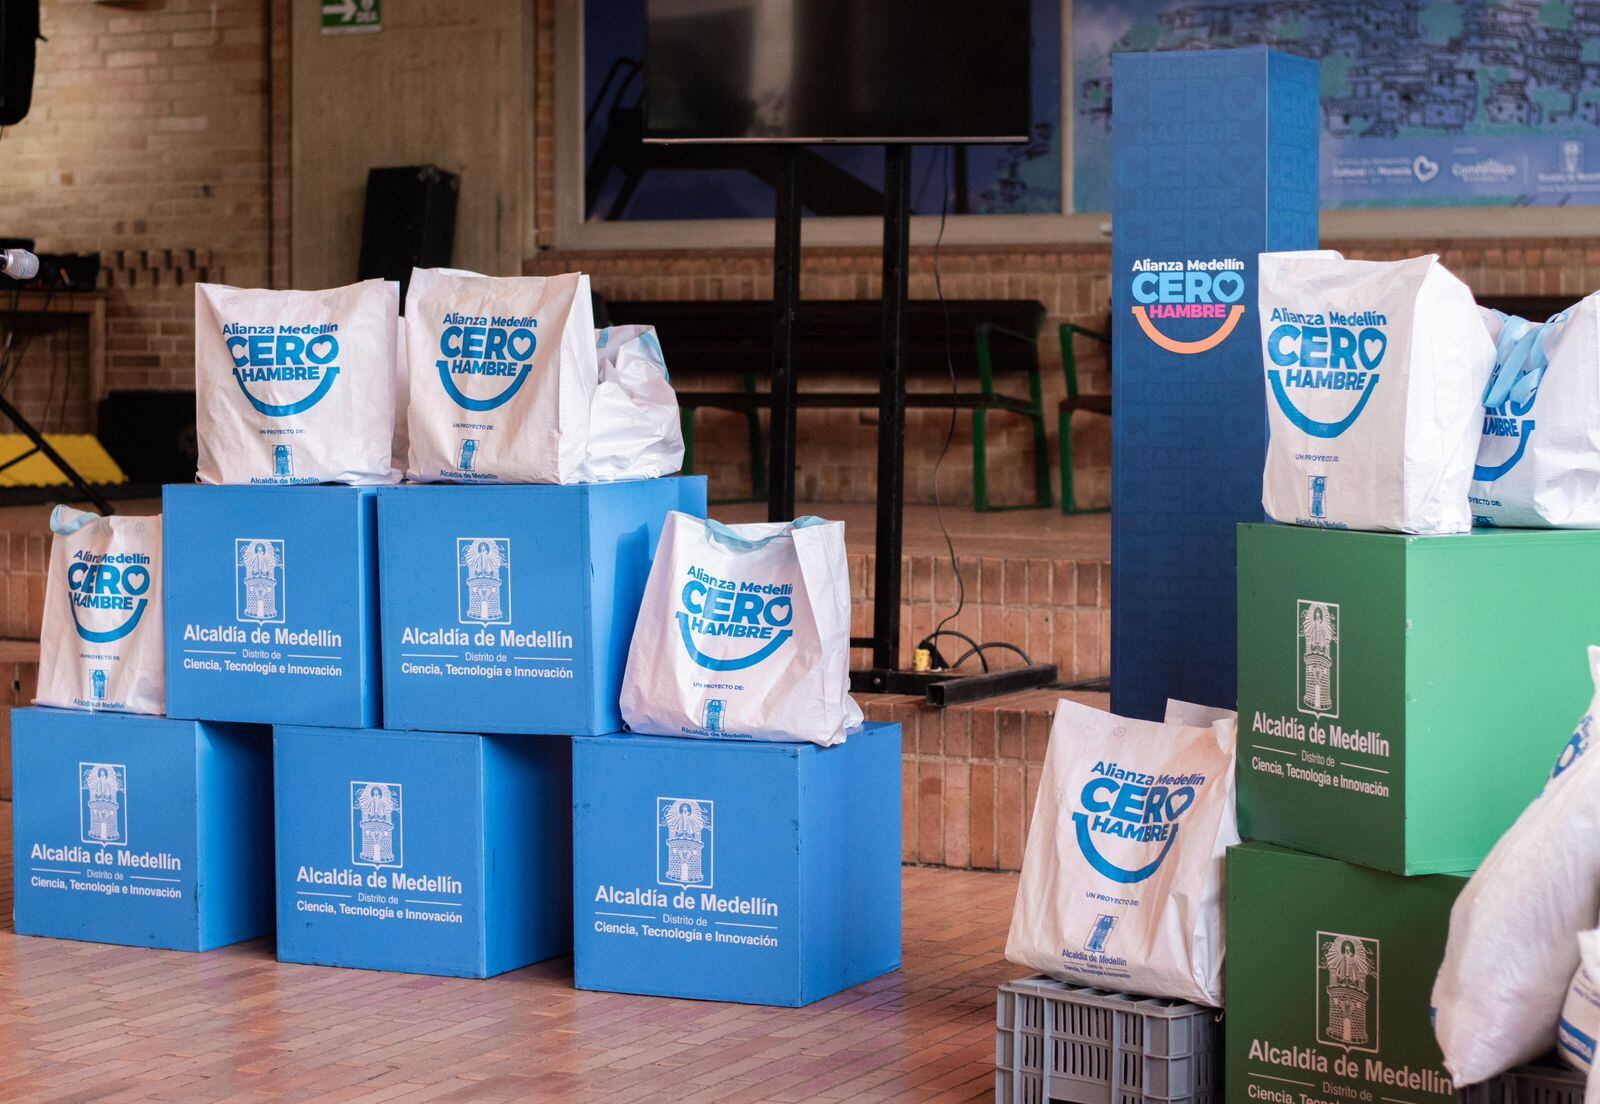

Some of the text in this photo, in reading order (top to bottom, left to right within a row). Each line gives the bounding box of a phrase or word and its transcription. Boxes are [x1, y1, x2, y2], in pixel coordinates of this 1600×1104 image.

[1132, 258, 1244, 271] Alianza Medellín
[1132, 271, 1244, 303] CERO
[443, 313, 538, 327] Alianza Medellín
[1150, 304, 1226, 318] HAMBRE
[1271, 307, 1387, 326] Alianza Medellín
[223, 322, 338, 335] Alianza Medellín
[226, 335, 339, 367] CERO
[440, 326, 536, 361] CERO
[1268, 324, 1387, 370] CERO
[242, 367, 320, 382] HAMBRE
[452, 360, 518, 376] HAMBRE
[1286, 369, 1367, 390] HAMBRE
[68, 562, 150, 596] CERO
[688, 566, 793, 595] Alianza Medellí
[74, 592, 133, 610] HAMBRE
[682, 580, 793, 626] CERO
[184, 624, 342, 647] Alcaldía de Medellín
[401, 628, 572, 648] Alcaldía de Medellín
[691, 617, 773, 639] HAMBRE
[243, 649, 281, 660] Distrito de
[465, 652, 507, 662] Distrito de
[184, 658, 342, 676] Ciencia, Tecnología e Innovación
[402, 663, 573, 678] Ciencia, Tecnología e Innovación
[1252, 711, 1389, 757] Alcaldía de Medellín
[1302, 750, 1335, 767] Distrito de
[1091, 761, 1205, 785] Alianza Medellín
[1252, 756, 1389, 797] Ciencia, Tecnología e Innovación
[1081, 777, 1195, 824] CERO
[1091, 816, 1170, 842] HAMBRE
[31, 843, 180, 870] Alcaldía de Medellín
[87, 869, 124, 881] Distrito de
[297, 866, 462, 894] Alcaldía de Medellín
[31, 876, 181, 898] Ciencia, Tecnología e Innovación
[358, 893, 398, 904] Distrito de
[595, 885, 778, 916] Alcaldía de Medellín
[1096, 894, 1129, 905] PROYECTO
[297, 901, 462, 923] Ciencia, Tecnología e Innovación
[663, 914, 708, 927] Distrito de
[595, 921, 777, 947] Ciencia, Tecnología e Innovación
[1248, 1039, 1453, 1095] Alcaldía de Medellín
[1323, 1081, 1357, 1099] Distrito
[1360, 1088, 1372, 1101] de
